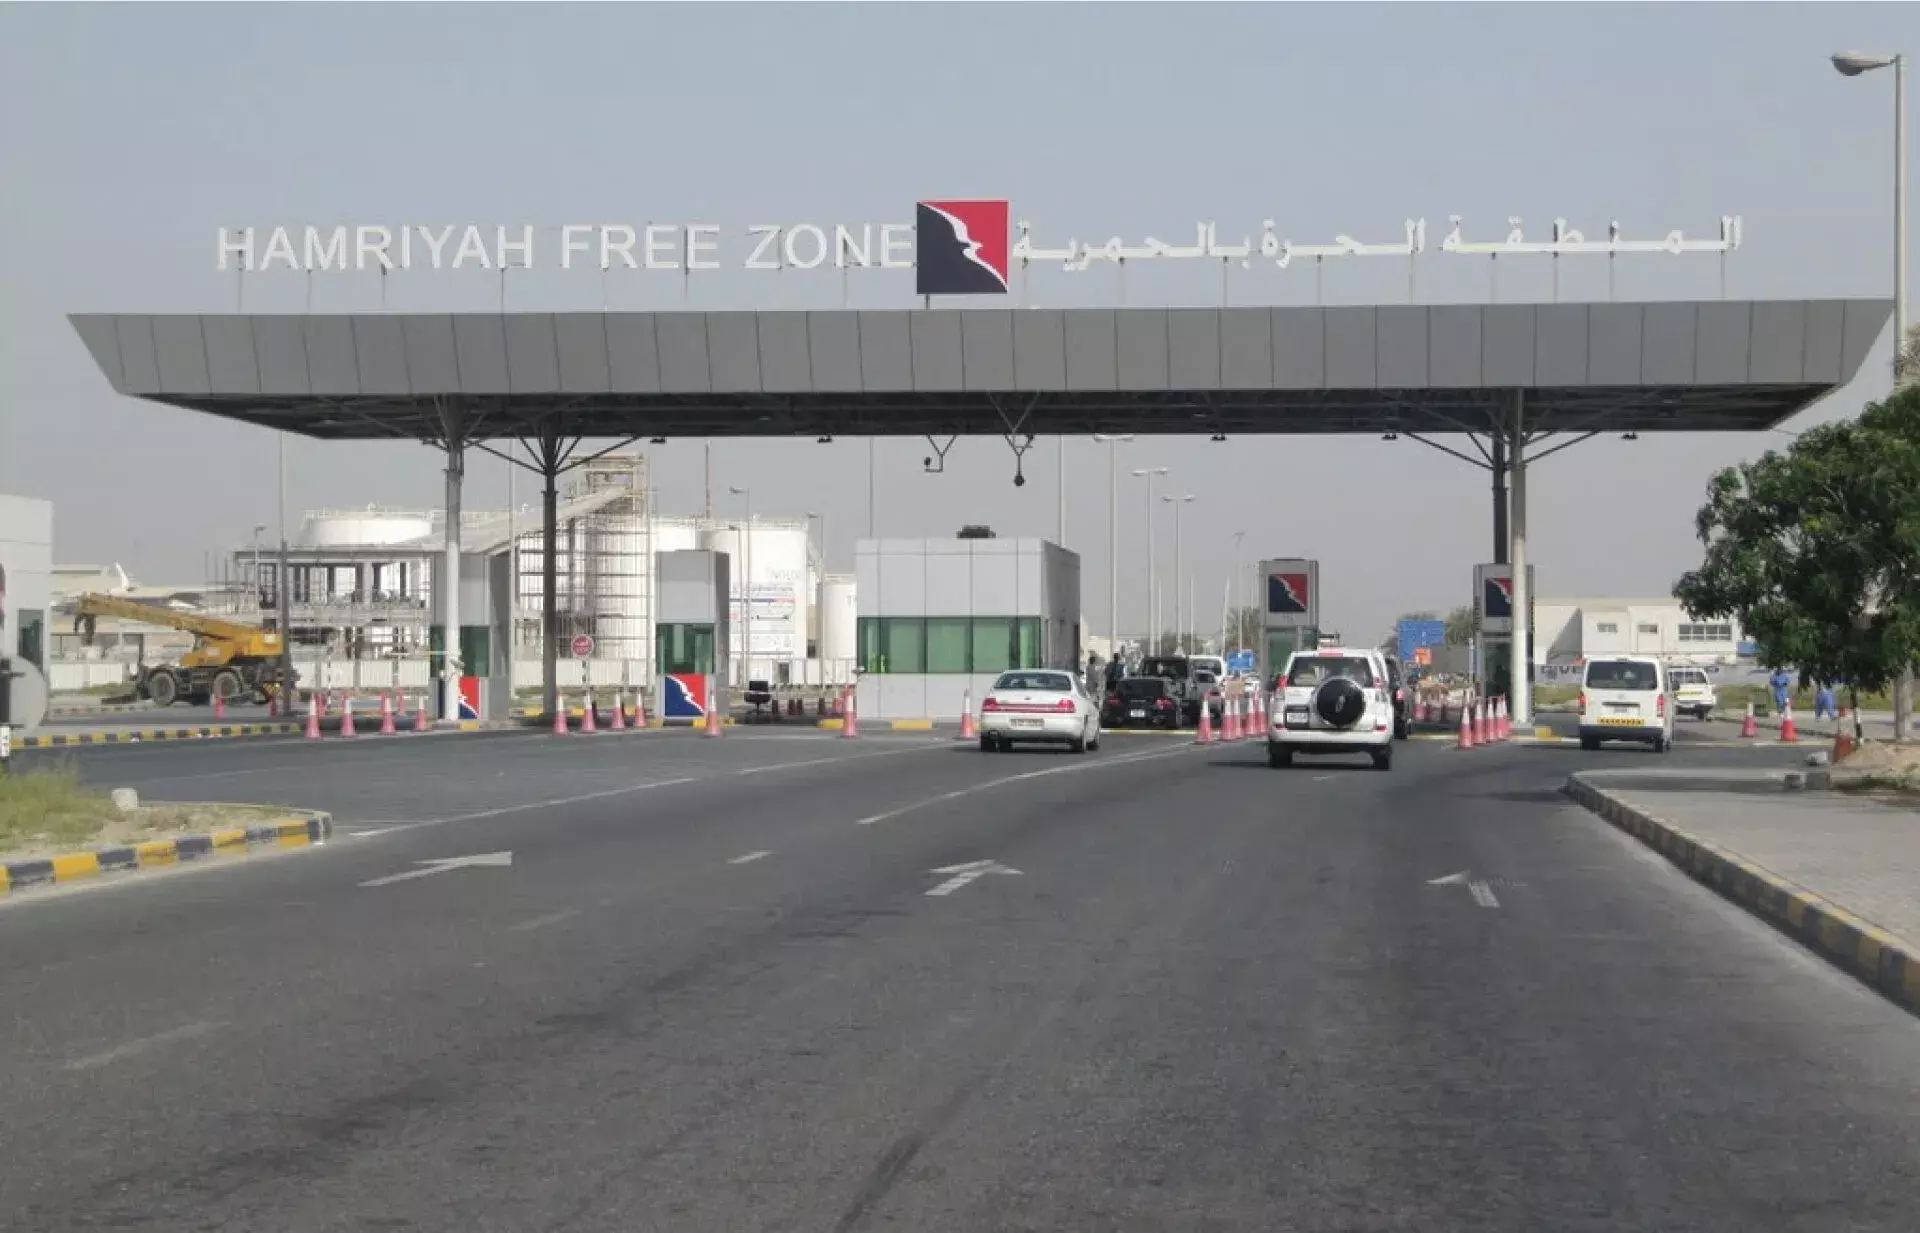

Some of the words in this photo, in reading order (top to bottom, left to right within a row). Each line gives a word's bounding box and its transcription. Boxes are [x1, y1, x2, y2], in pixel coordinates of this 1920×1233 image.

[217, 224, 534, 270] HAMRIYAH
[562, 224, 721, 269] FREE
[744, 223, 914, 269] ZONE
[1012, 216, 1251, 272] بالحمرية
[1261, 216, 1426, 269] الحرة
[1441, 214, 1741, 255] المنطقة
